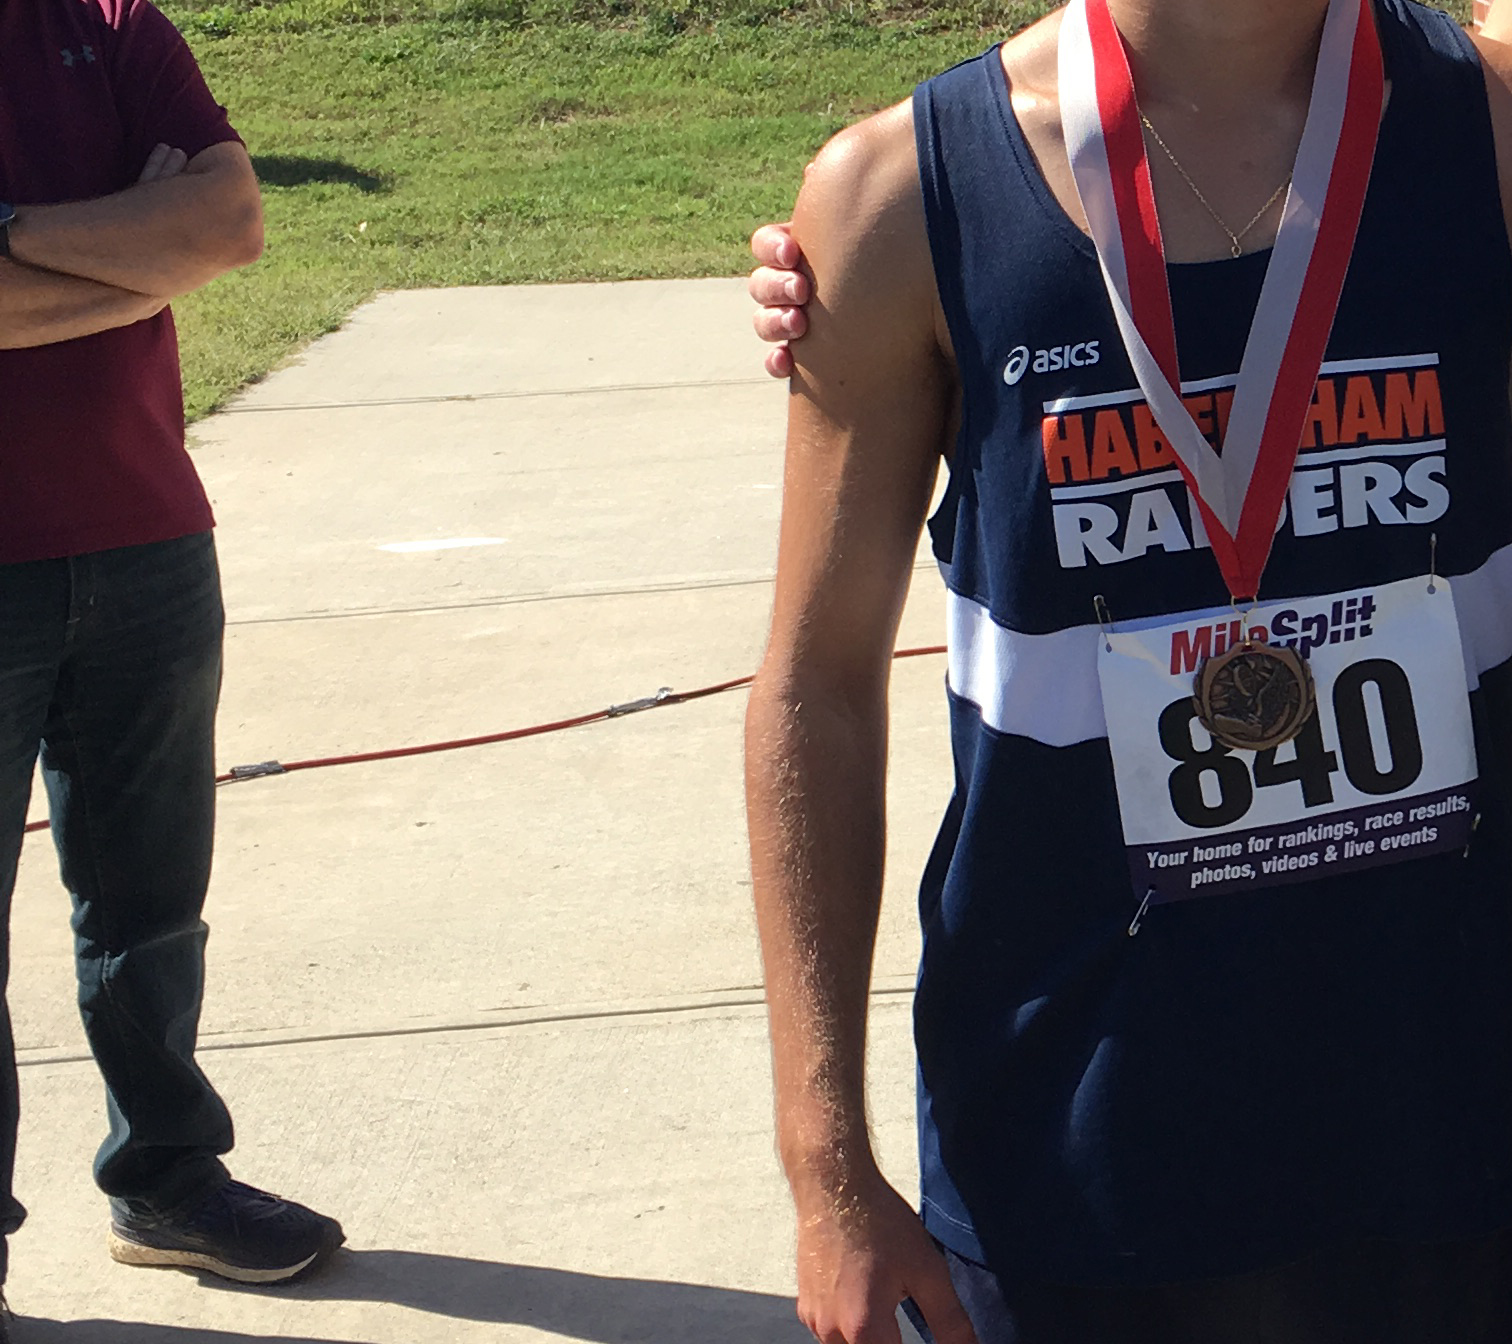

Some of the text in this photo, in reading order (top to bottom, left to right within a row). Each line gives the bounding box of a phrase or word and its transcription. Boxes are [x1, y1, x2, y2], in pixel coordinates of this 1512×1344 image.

[1032, 340, 1100, 374] asics
[1157, 657, 1424, 829] 840
[1146, 794, 1472, 869] Your home for rankings, race results,
[1190, 825, 1439, 890] photos, videos & live events
